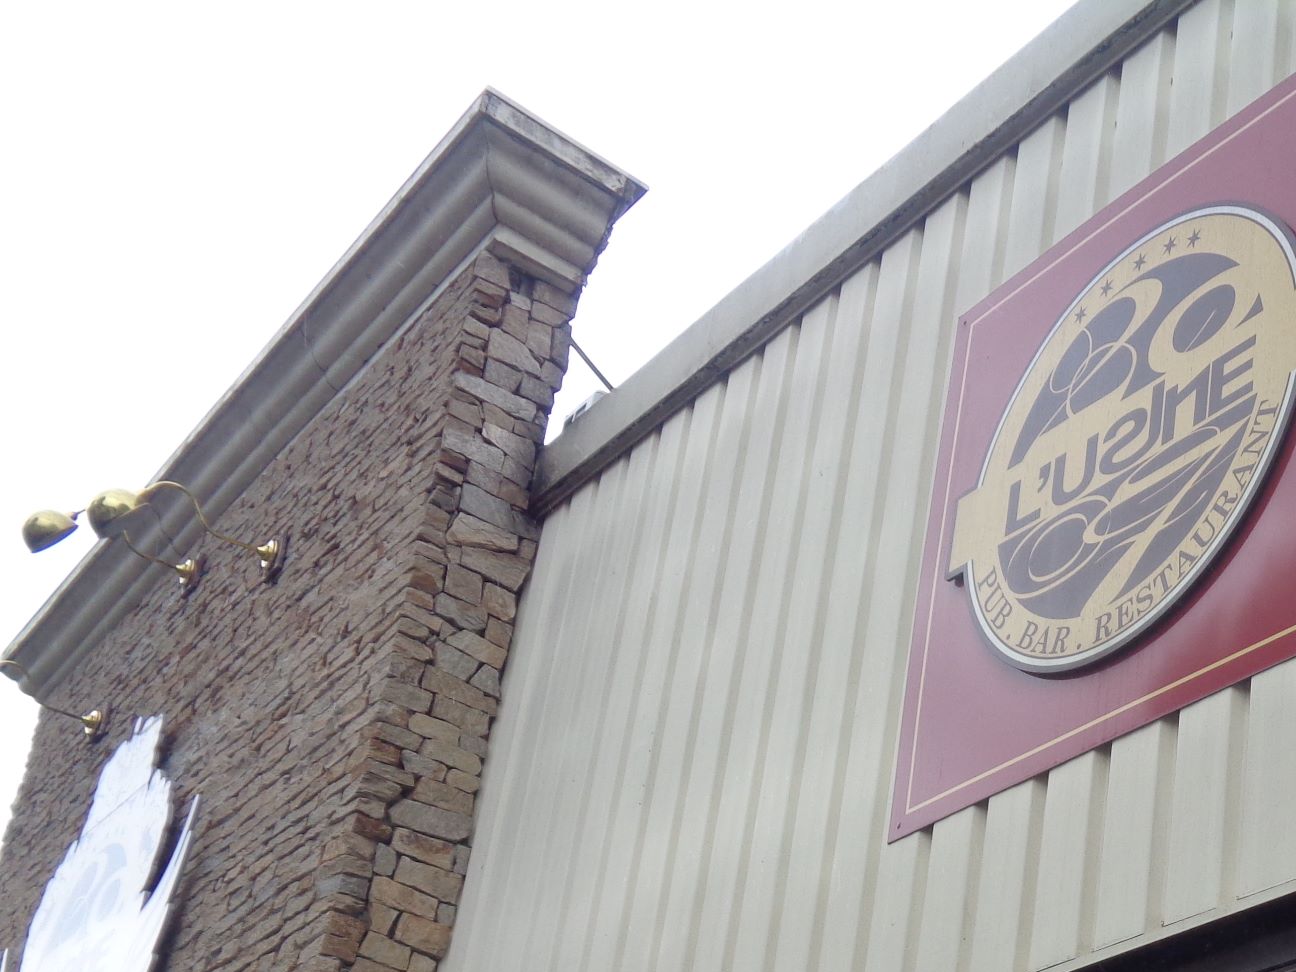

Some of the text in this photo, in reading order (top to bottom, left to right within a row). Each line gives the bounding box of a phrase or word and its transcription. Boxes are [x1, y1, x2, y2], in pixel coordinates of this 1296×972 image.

[978, 400, 1279, 655] PUB BAR RESTAURANT
